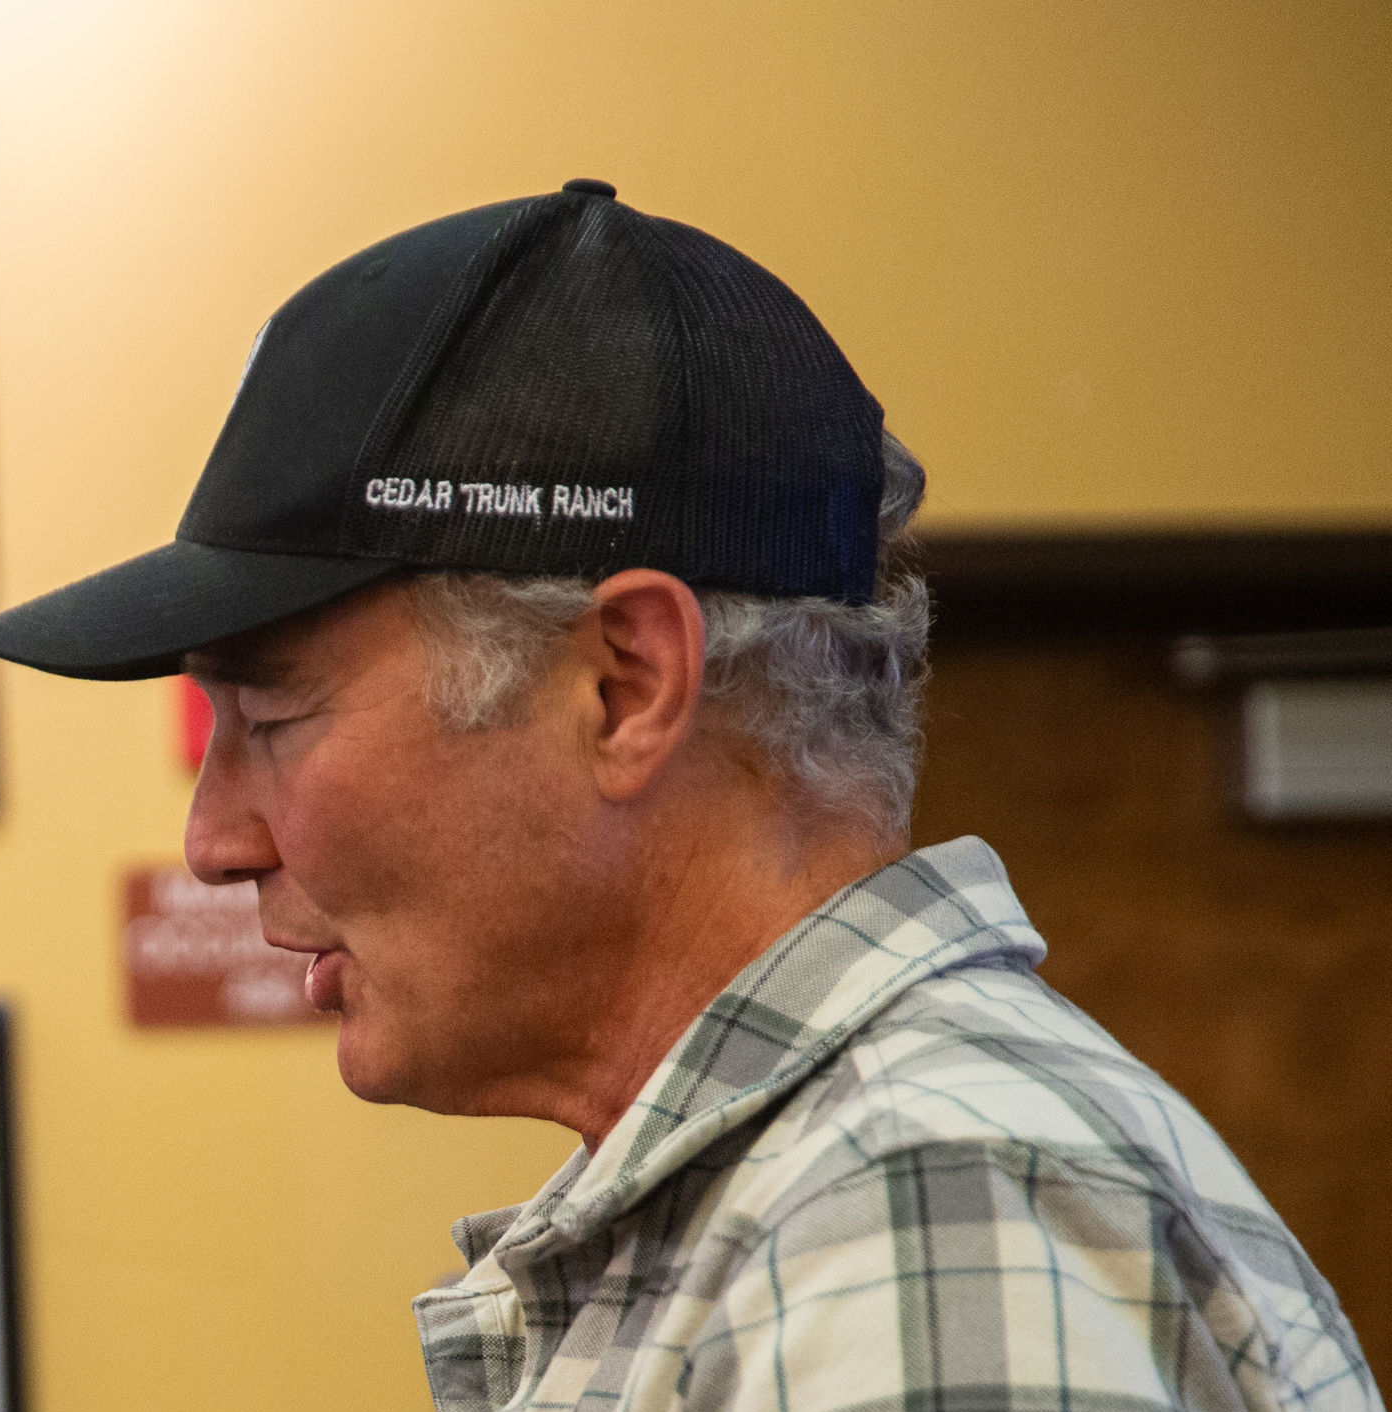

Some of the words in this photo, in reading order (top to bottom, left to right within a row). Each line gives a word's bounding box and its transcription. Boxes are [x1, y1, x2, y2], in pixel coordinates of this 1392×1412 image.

[366, 477, 453, 510] CEDAR
[460, 482, 543, 515] TRUNK
[551, 484, 634, 518] RANCH
